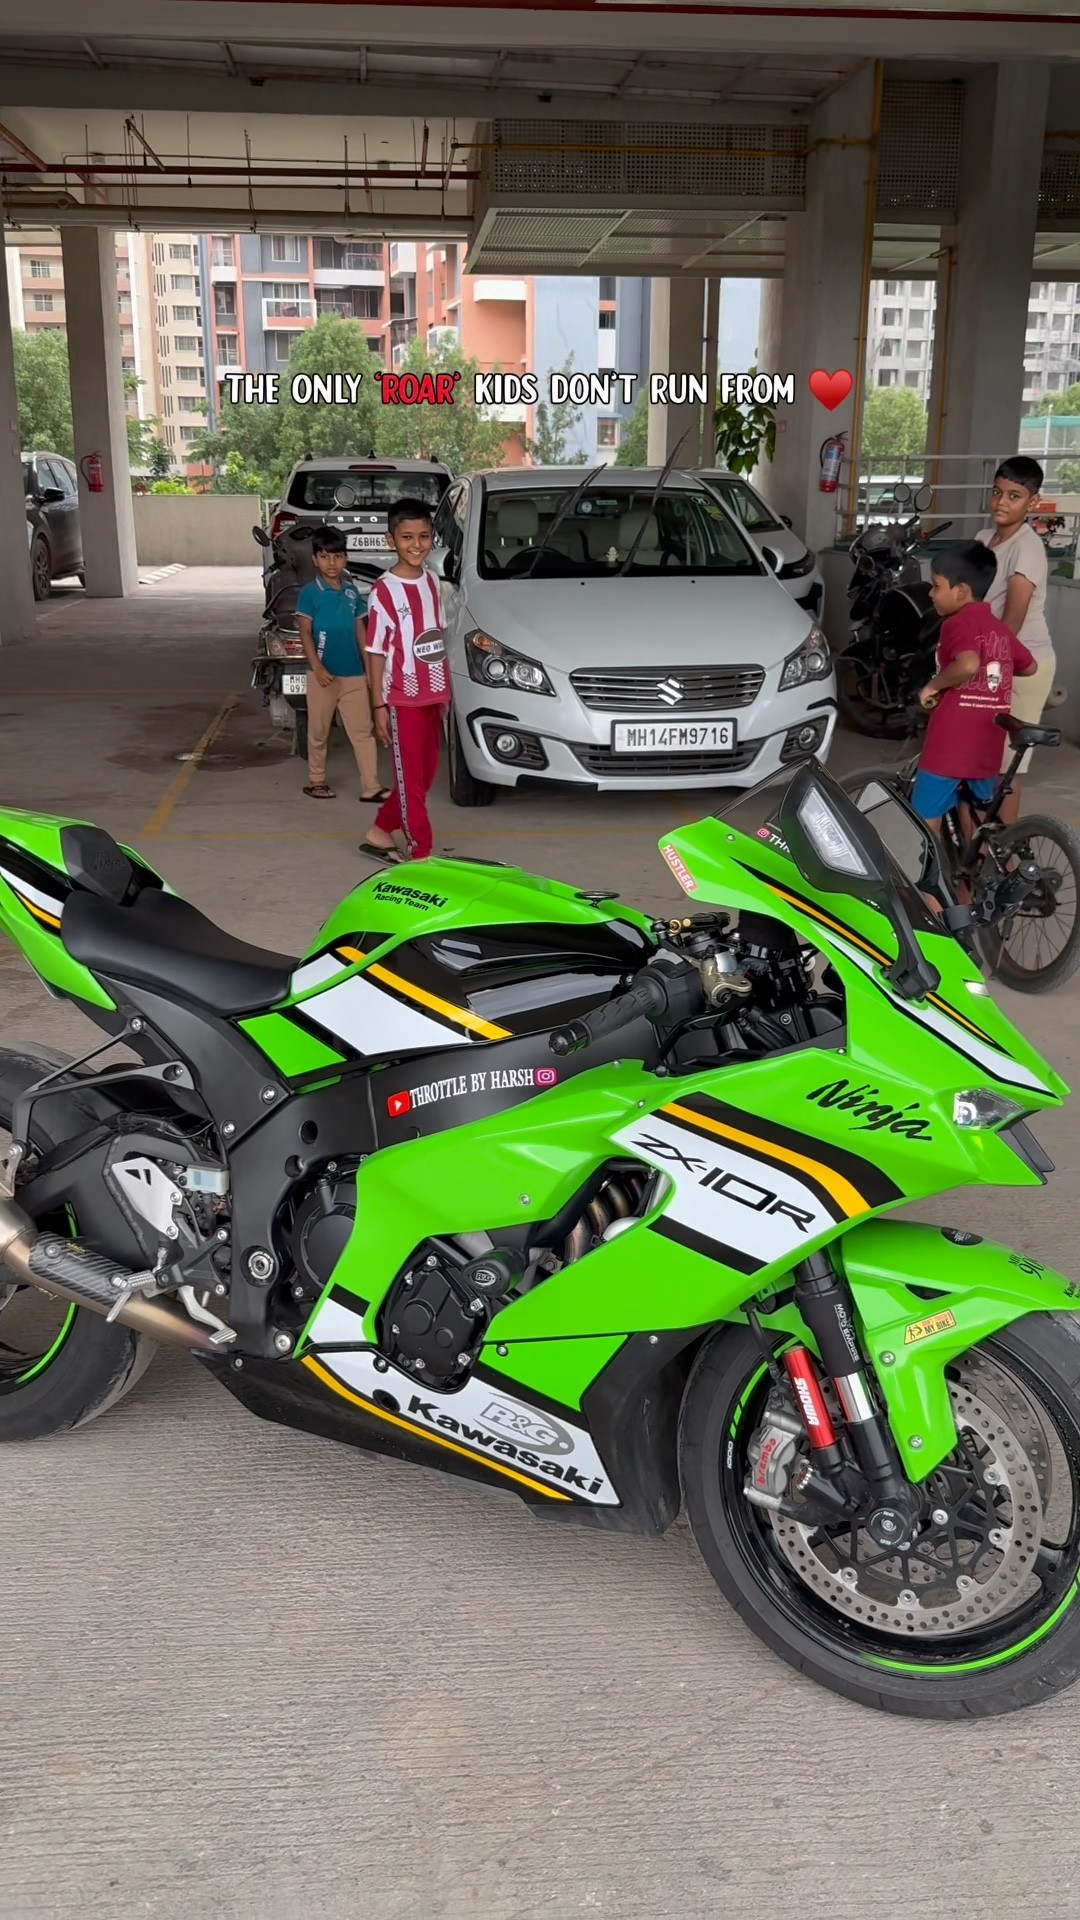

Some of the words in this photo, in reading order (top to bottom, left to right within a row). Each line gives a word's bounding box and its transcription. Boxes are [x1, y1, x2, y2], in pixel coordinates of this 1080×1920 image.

[626, 727, 729, 747] MH14FM9716
[372, 881, 449, 908] Kawasaki
[374, 893, 403, 905] Racing
[403, 897, 429, 911] Team
[409, 1074, 468, 1108] THROTTLE
[470, 1072, 487, 1093] BY
[490, 1068, 535, 1090] HARSH
[806, 1079, 933, 1141] Ninja
[630, 1132, 816, 1234] ZX-10R
[480, 1400, 560, 1446] R&G
[793, 1376, 820, 1427] SHOWA
[407, 1394, 604, 1495] Kawasaki
[755, 1437, 777, 1486] brembo
